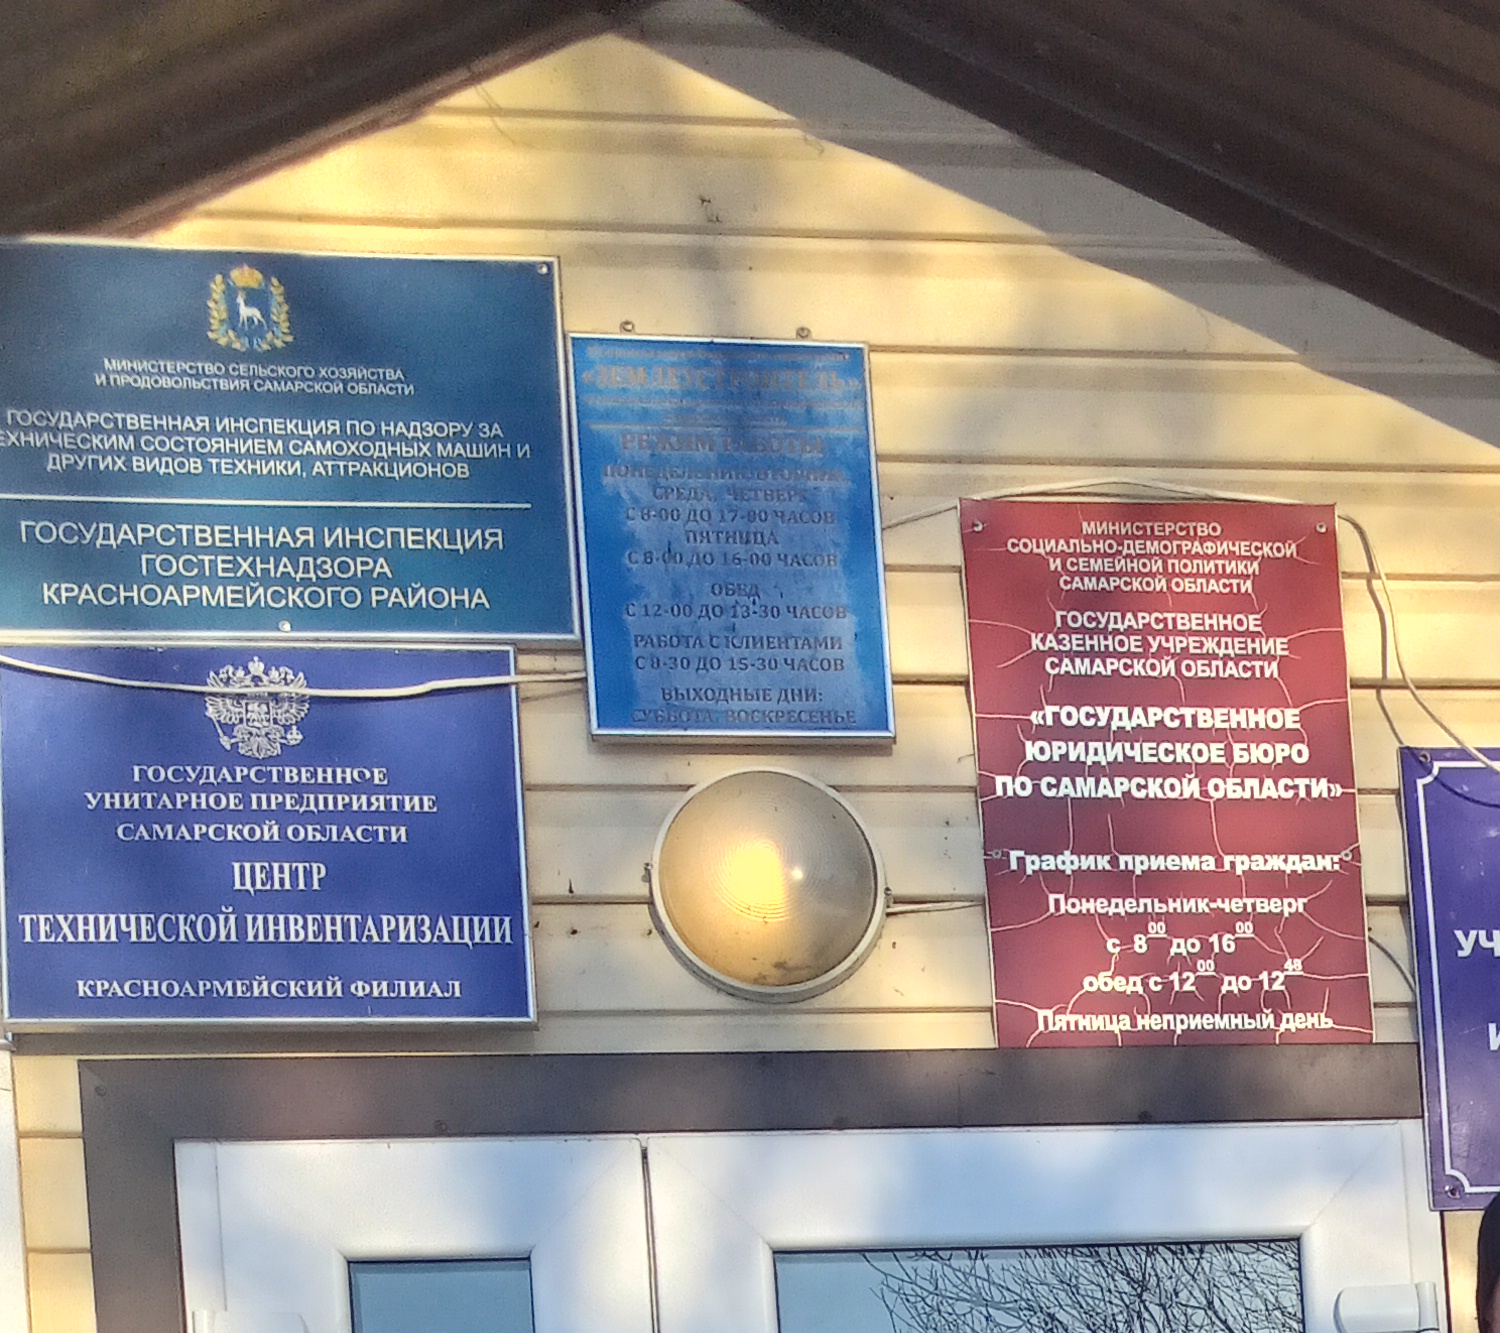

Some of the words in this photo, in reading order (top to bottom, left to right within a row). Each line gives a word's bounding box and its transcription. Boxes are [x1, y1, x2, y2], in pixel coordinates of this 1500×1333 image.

[103, 357, 226, 376] МИНИСТЕРСТВО
[228, 362, 316, 379] СЕЛЬСКОГО
[318, 365, 405, 381] ХОЗЯЙСТВА
[95, 374, 107, 387] И
[109, 374, 250, 391] ПРОДОВОЛЬСТВИЯ
[253, 379, 344, 394] САМАРСКОЙ
[347, 382, 415, 396] ОБЛАСТИ
[6, 409, 210, 432] ГОСУДАРСТВЕННАЯ
[215, 417, 341, 438] ИНСПЕКЦИЯ
[346, 421, 376, 437] ПО
[381, 421, 474, 440] НАДЗОРУ
[478, 422, 505, 438] ЗА
[140, 436, 283, 455] СОСТОЯНИЕМ
[289, 440, 432, 459] САМОХОДНЫХ
[436, 443, 511, 459] МАШИН
[516, 443, 531, 459] И
[46, 453, 127, 473] ДРУГИХ
[132, 456, 202, 475] ВИДОВ
[207, 458, 307, 478] ТЕХНИКИ,
[311, 460, 470, 481] АТТРАКЦИОНОВ
[684, 509, 712, 526] ДО
[774, 510, 836, 525] ЧАСОВ
[1081, 520, 1222, 538] МИНИСТЕРСТВО
[19, 520, 315, 549] ГОСУДАРСТВЕННАЯ
[323, 528, 504, 554] ИНСПЕКЦИЯ
[684, 530, 780, 549] ПЯТНИЦА
[1006, 536, 1299, 558] СОЦИАЛЬНО-ДЕМОГРАФИЧЕСКОЙ
[140, 553, 393, 582] ГОСТЕХНАДЗОРА
[688, 552, 715, 569] ДО
[777, 554, 839, 568] ЧАСОВ
[1049, 557, 1063, 572] И
[1066, 553, 1164, 574] СЕМЕЙНОЙ
[1168, 558, 1260, 575] ПОЛИТИКИ
[41, 578, 362, 609] КРАСНОАРМЕЙСКОГО
[370, 581, 491, 610] РАЙОНА
[711, 582, 761, 600] ОБЕД
[1058, 572, 1167, 593] САМАРСКОЙ
[1171, 576, 1253, 594] ОБЛАСТИ
[625, 603, 637, 619] С
[641, 604, 694, 619] 12-00
[697, 604, 725, 621] ДО
[786, 605, 848, 620] ЧАСОВ
[1055, 610, 1263, 633] ГОСУДАРСТВЕННОЕ
[633, 634, 702, 651] РАБОТА
[709, 635, 721, 650] С
[724, 635, 843, 651] КЛИЕНТАМИ
[1030, 633, 1144, 654] КАЗЕННОЕ
[1148, 636, 1290, 657] УЧРЕЖДЕНИЕ
[635, 656, 647, 671] С
[694, 657, 722, 675] ДО
[728, 657, 779, 672] 15-30
[783, 658, 845, 673] ЧАСОВ
[1044, 655, 1176, 678] САМАРСКОЙ
[1180, 661, 1279, 679] ОБЛАСТИ
[661, 686, 772, 705] ВЫХОДНЫЕ
[777, 688, 824, 705] ДНИ:
[725, 709, 857, 725] ВОСКРЕСЕНЬЕ
[1030, 704, 1301, 731] «ГОСУДАРСТВЕННОЕ
[1024, 739, 1227, 766] ЮРИДИЧЕСКОЕ
[1233, 742, 1310, 765] БЮРО
[132, 764, 389, 786] ГОСУДАРСТВЕННОЕ
[995, 776, 1034, 798] ПО
[1039, 773, 1201, 799] САМАРСКОЙ
[1207, 777, 1343, 799] ОБЛАСТИ»
[83, 791, 244, 811] УНИТАРНОЕ
[249, 792, 438, 814] ПРЕДПРИЯТИЕ
[116, 819, 280, 843] САМАРСКОЙ
[286, 824, 409, 843] ОБЛАСТИ
[1009, 849, 1112, 875] График
[1118, 853, 1216, 875] приема
[1224, 852, 1341, 874] граждан:
[231, 861, 328, 896] ЦЕНТР
[1047, 893, 1308, 916] Понедельник-четверг
[18, 905, 240, 944] ТЕХНИЧЕСКОЙ
[245, 913, 513, 949] ИНВЕНТАРИЗАЦИИ
[1106, 938, 1122, 954] с
[1169, 937, 1201, 956] до
[76, 975, 344, 998] КРАСНОАРМЕЙСКИЙ
[349, 978, 463, 999] ФИЛИАЛ
[1082, 972, 1144, 995] обед
[1148, 977, 1163, 992] с
[1221, 976, 1252, 994] до
[1036, 1009, 1131, 1033] Пятница
[1135, 1009, 1275, 1034] неприемный
[1279, 1013, 1334, 1032] день
